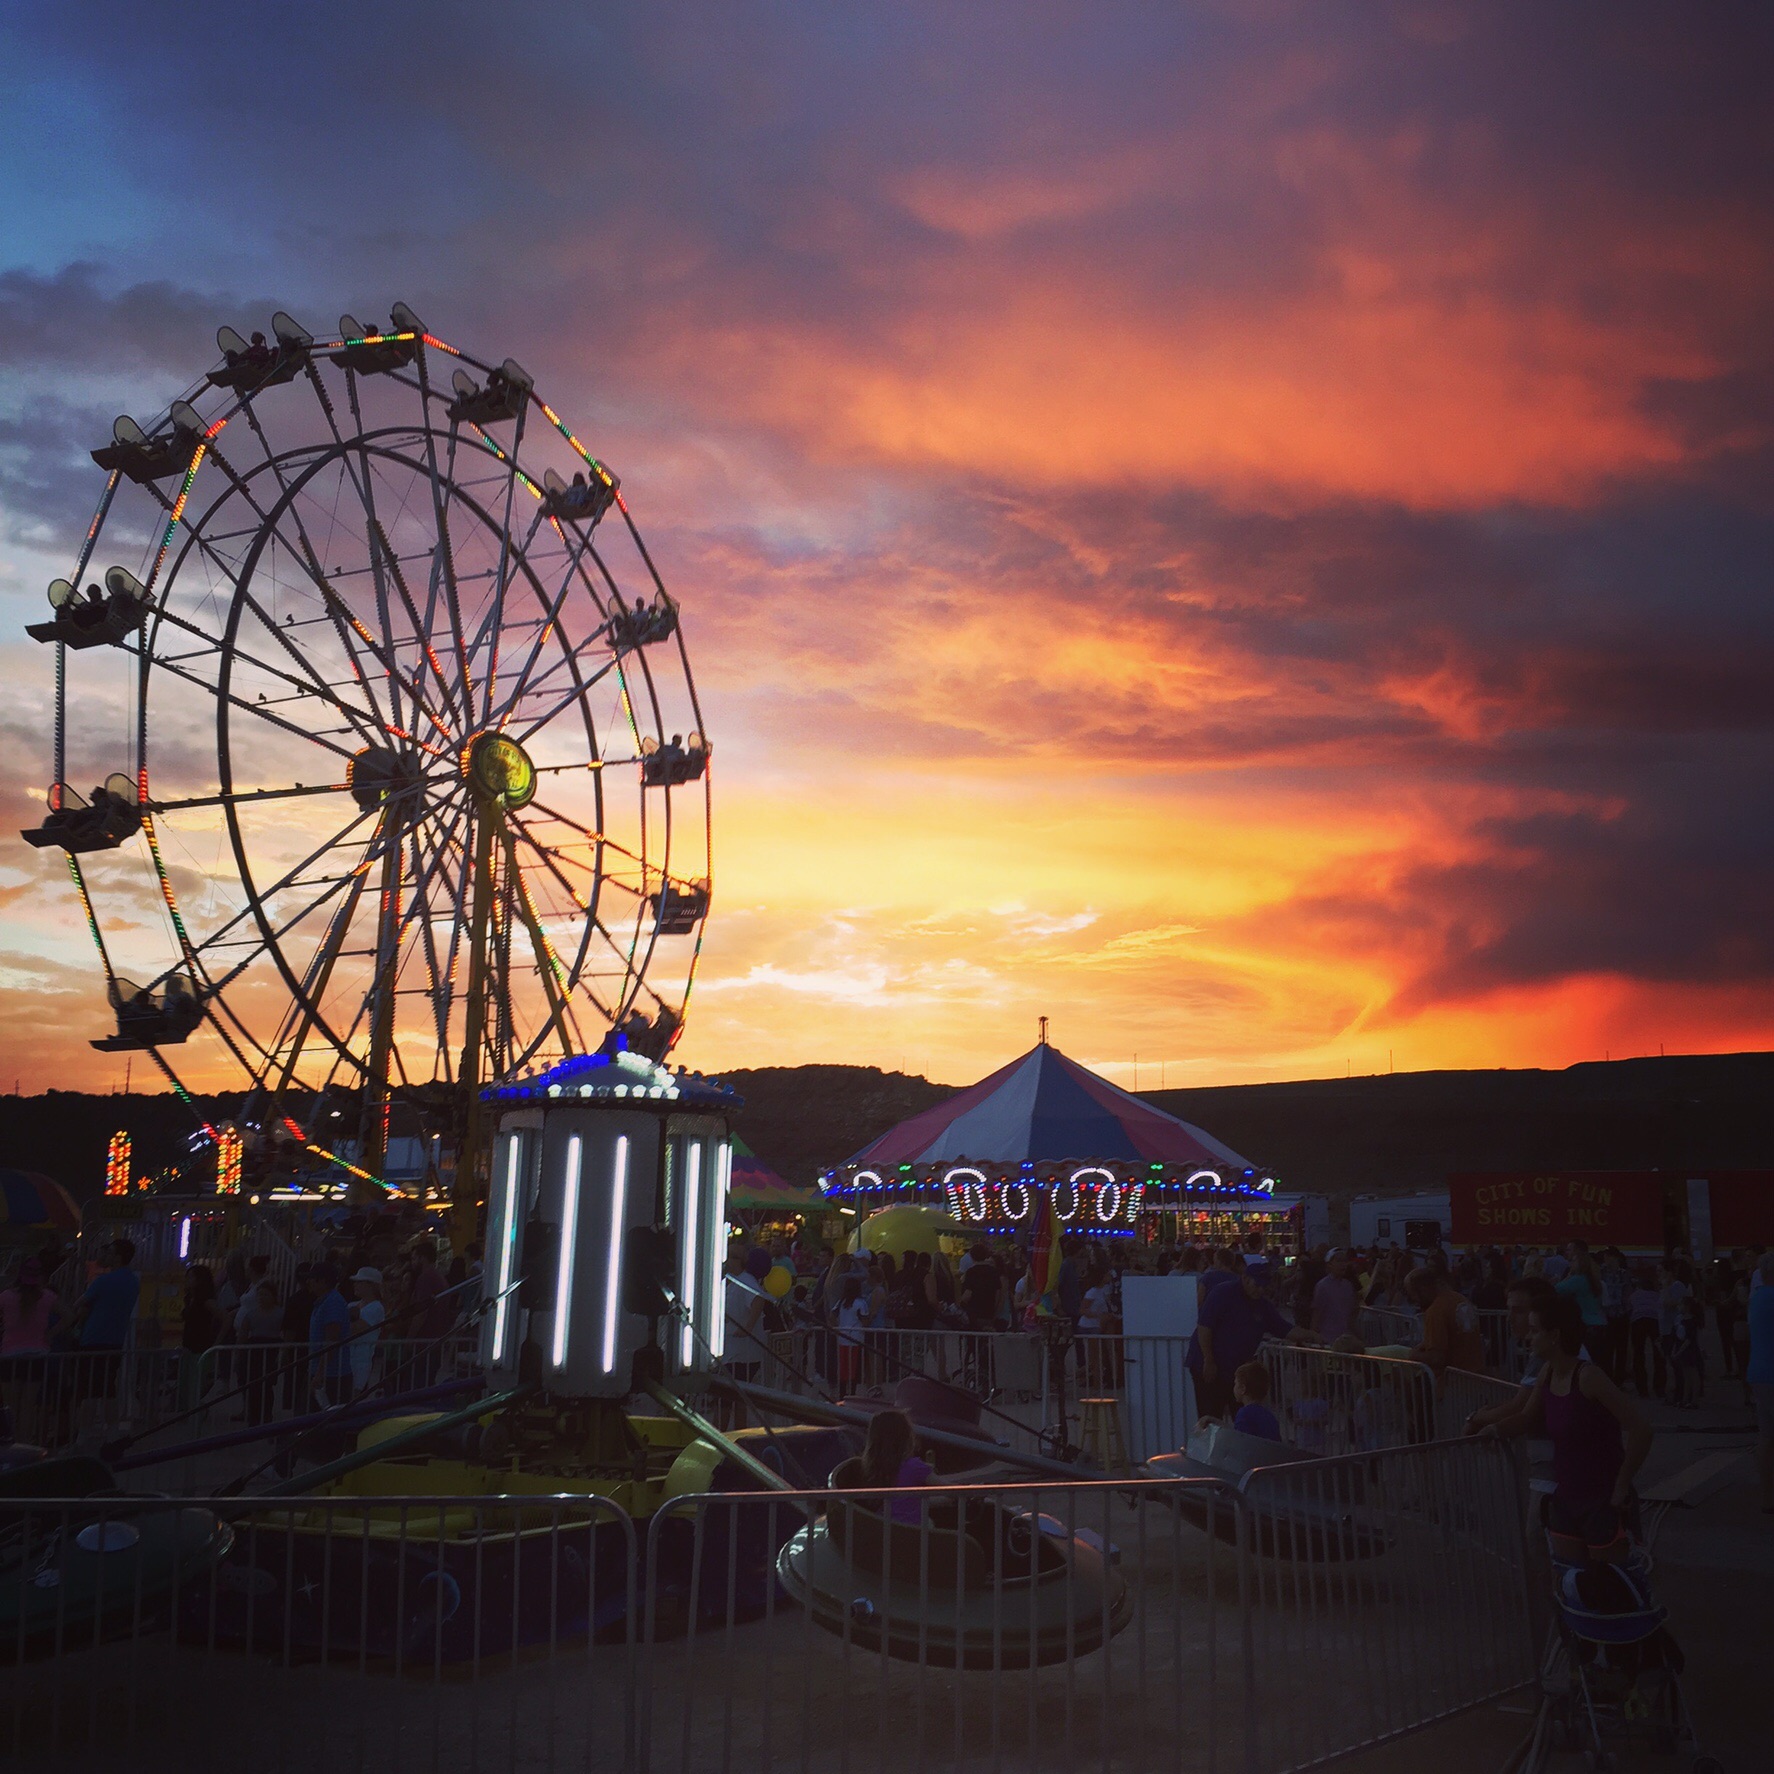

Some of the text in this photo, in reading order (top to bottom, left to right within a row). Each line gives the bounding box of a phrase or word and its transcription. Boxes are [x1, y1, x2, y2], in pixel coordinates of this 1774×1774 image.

[1475, 1177, 1612, 1206] CITY OF FUN
[1477, 1208, 1609, 1226] SHOWS INC
